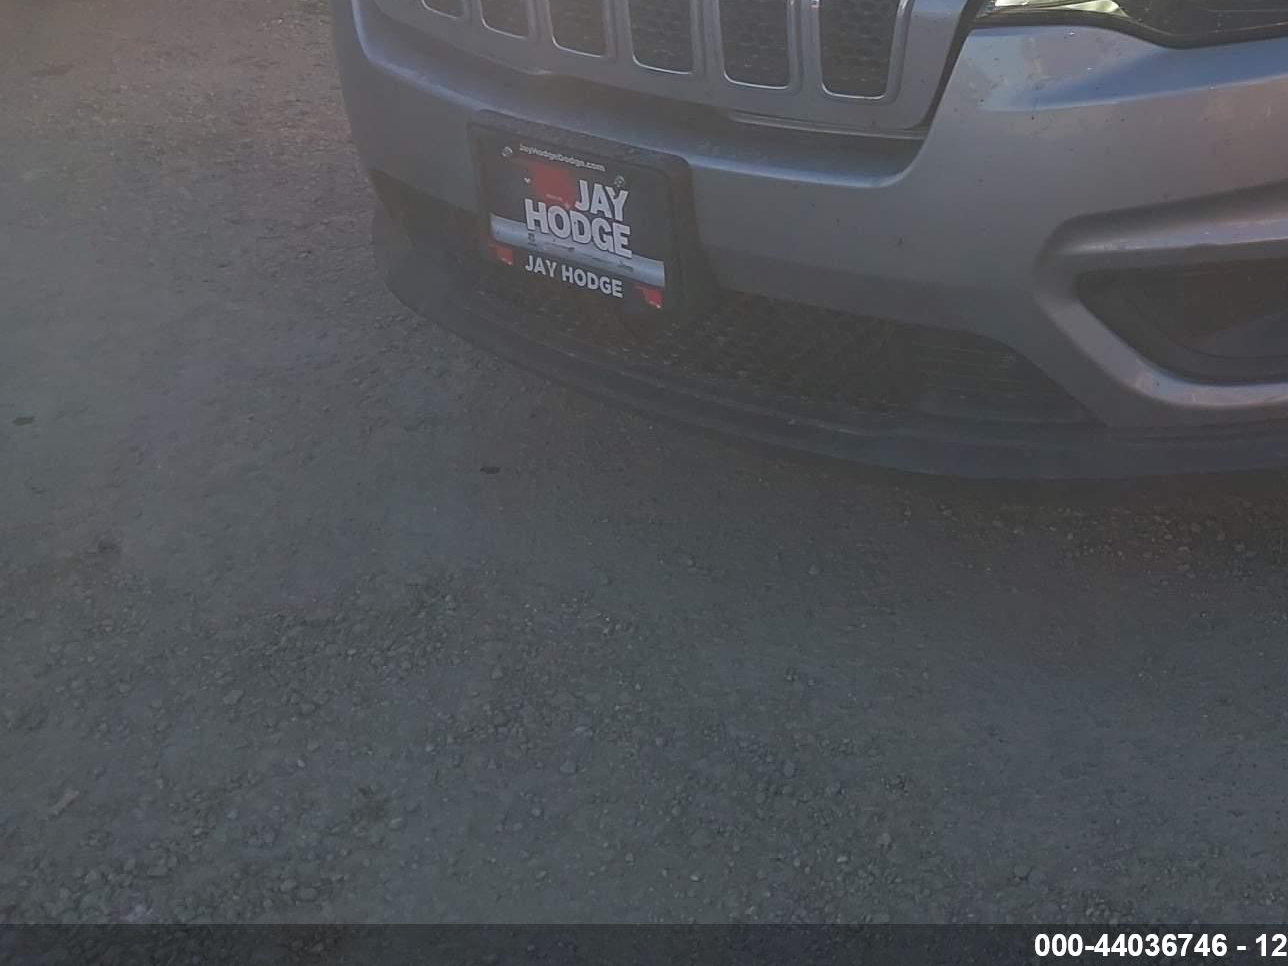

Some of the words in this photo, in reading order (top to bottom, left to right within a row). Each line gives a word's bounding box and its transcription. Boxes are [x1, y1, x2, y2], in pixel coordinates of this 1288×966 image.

[575, 179, 629, 221] JAY
[524, 198, 632, 259] HODGE
[525, 255, 558, 278] JAY
[561, 265, 623, 298] HODGE
